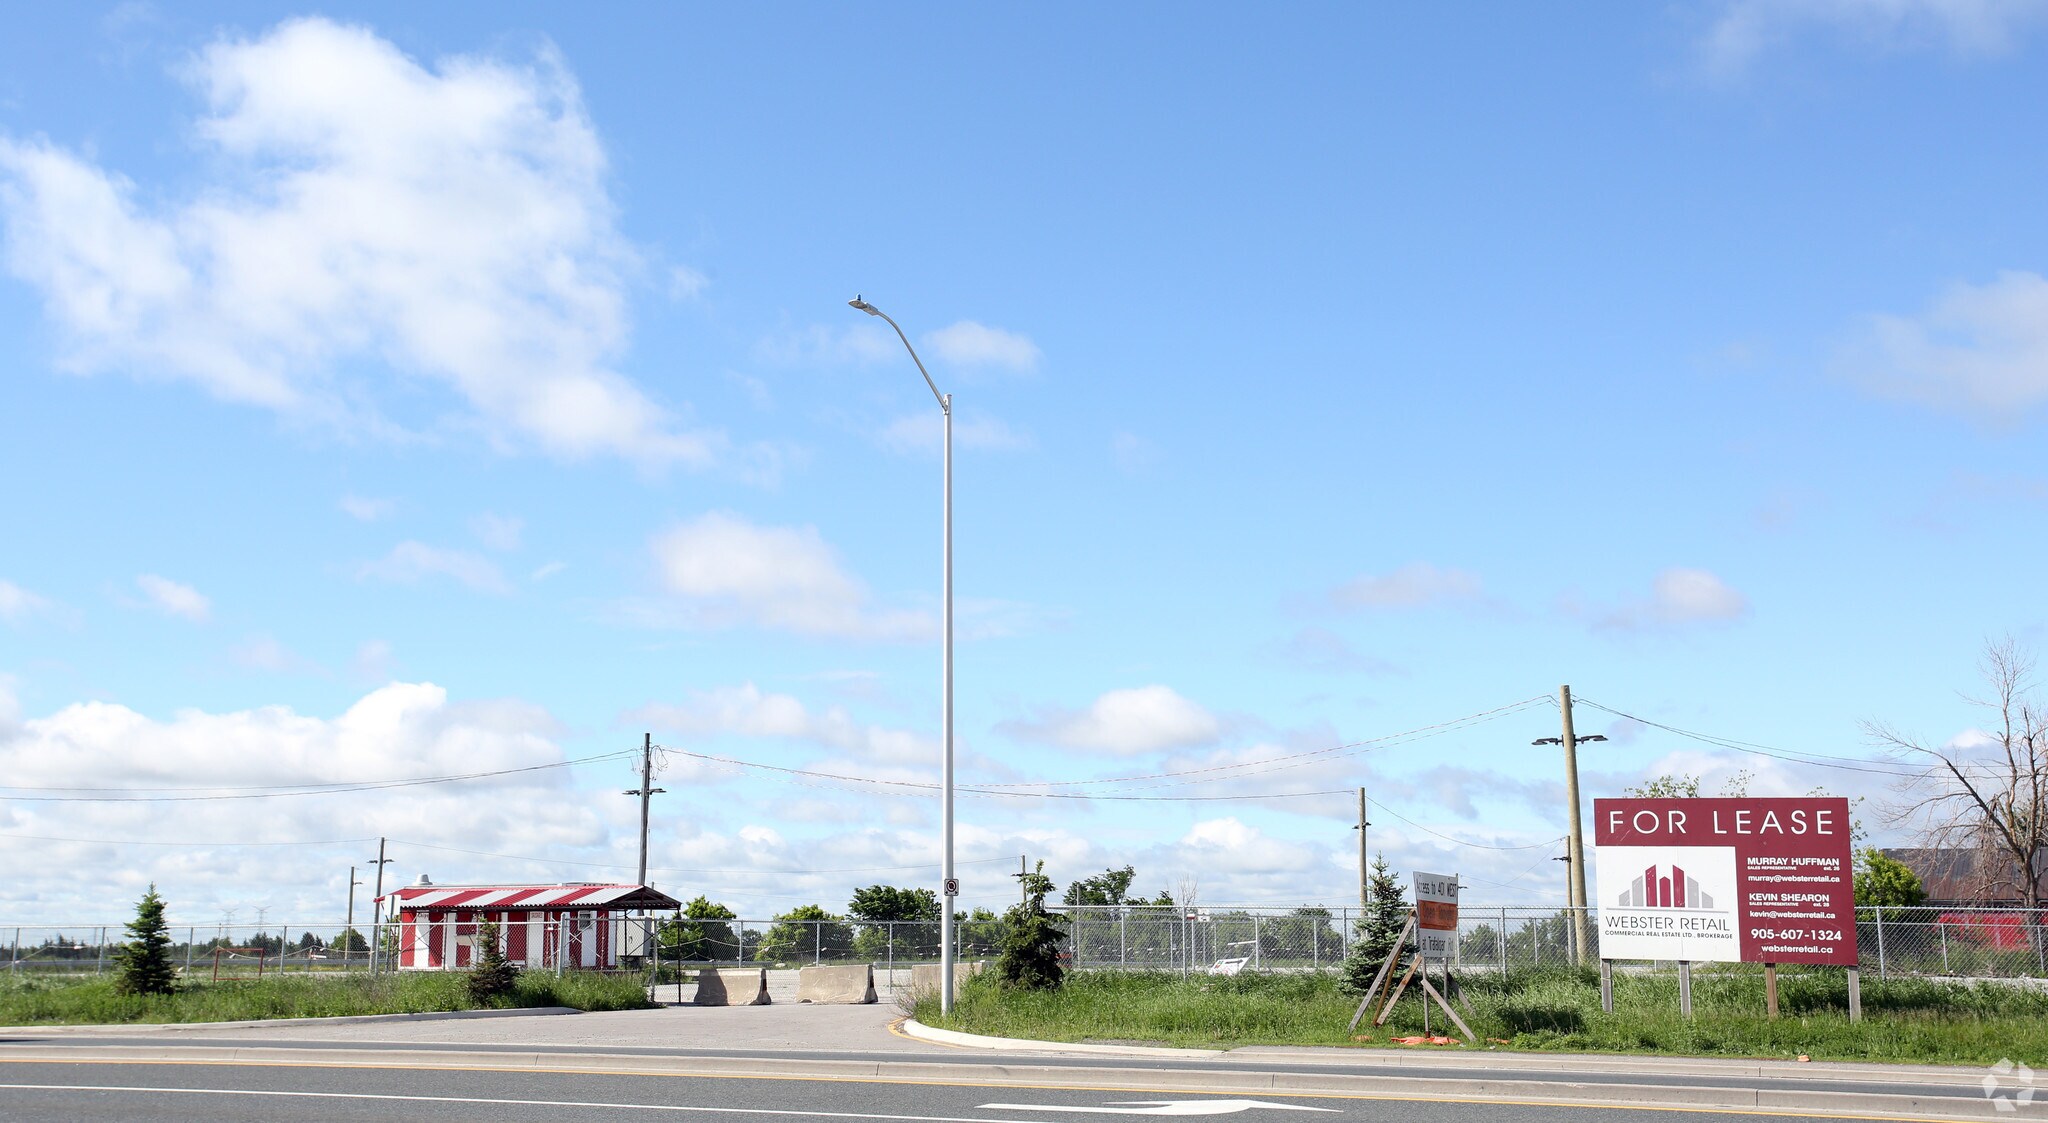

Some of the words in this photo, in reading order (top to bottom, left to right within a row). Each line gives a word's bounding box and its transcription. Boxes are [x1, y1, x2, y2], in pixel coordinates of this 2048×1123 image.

[1609, 810, 1687, 834] FOR
[1713, 810, 1833, 835] LEASE
[1747, 857, 1788, 865] MURRAY
[1791, 858, 1840, 866] HUFFMAN
[1748, 875, 1840, 883] murray@websterretail.ca
[1749, 893, 1778, 901] KEVIN
[1781, 894, 1830, 902] SHEARON
[1750, 910, 1836, 919] kevin@websterretail.ca
[1605, 916, 1674, 929] WEBSTER
[1680, 917, 1730, 931] RETAIL
[1751, 929, 1842, 941] 905-607-1324
[1761, 945, 1833, 954] websterretail.ca
